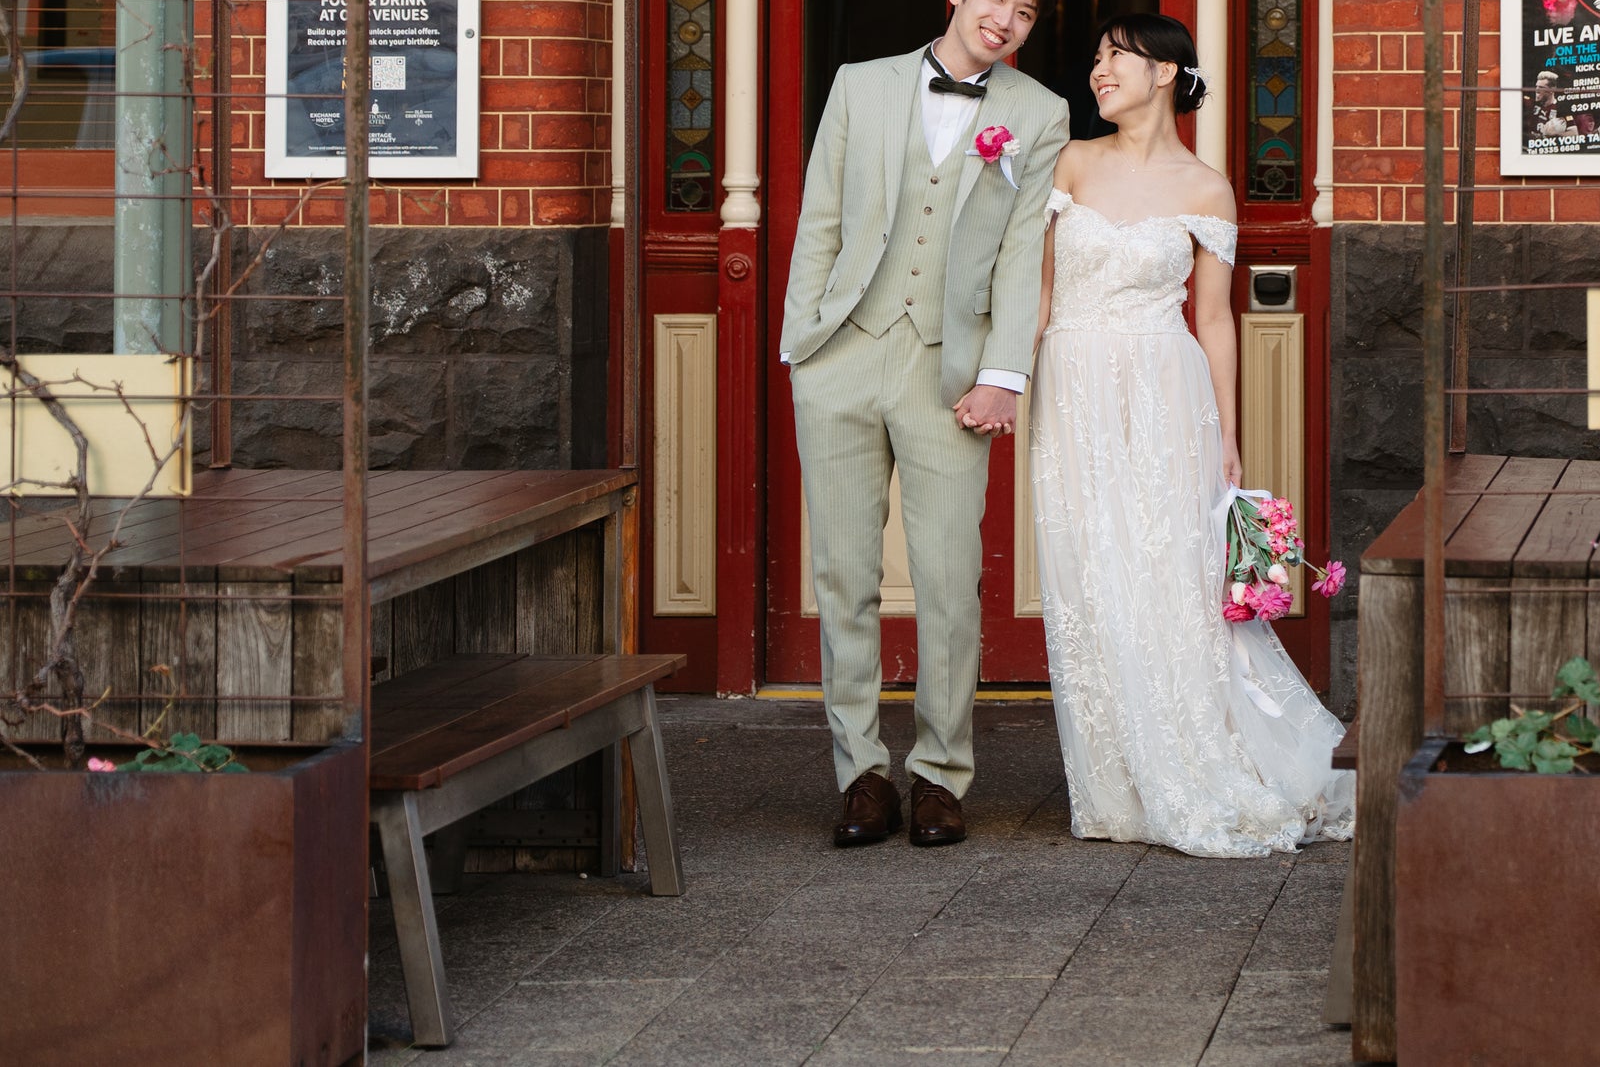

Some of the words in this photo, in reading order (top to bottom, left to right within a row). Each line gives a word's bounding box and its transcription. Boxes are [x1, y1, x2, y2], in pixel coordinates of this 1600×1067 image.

[320, 9, 337, 21] AT
[373, 9, 429, 21] VENUES
[392, 28, 416, 36] special
[1534, 26, 1574, 46] LIVE
[407, 38, 440, 46] birthday.
[1556, 46, 1573, 56] ON
[1576, 44, 1597, 54] THE
[1545, 58, 1557, 67] AT
[1559, 56, 1577, 65] THE
[1576, 64, 1595, 73] KICK
[1573, 77, 1600, 87] BRING
[1571, 103, 1589, 112] $20
[1528, 138, 1557, 148] BOOK
[1558, 135, 1585, 145] YOUR
